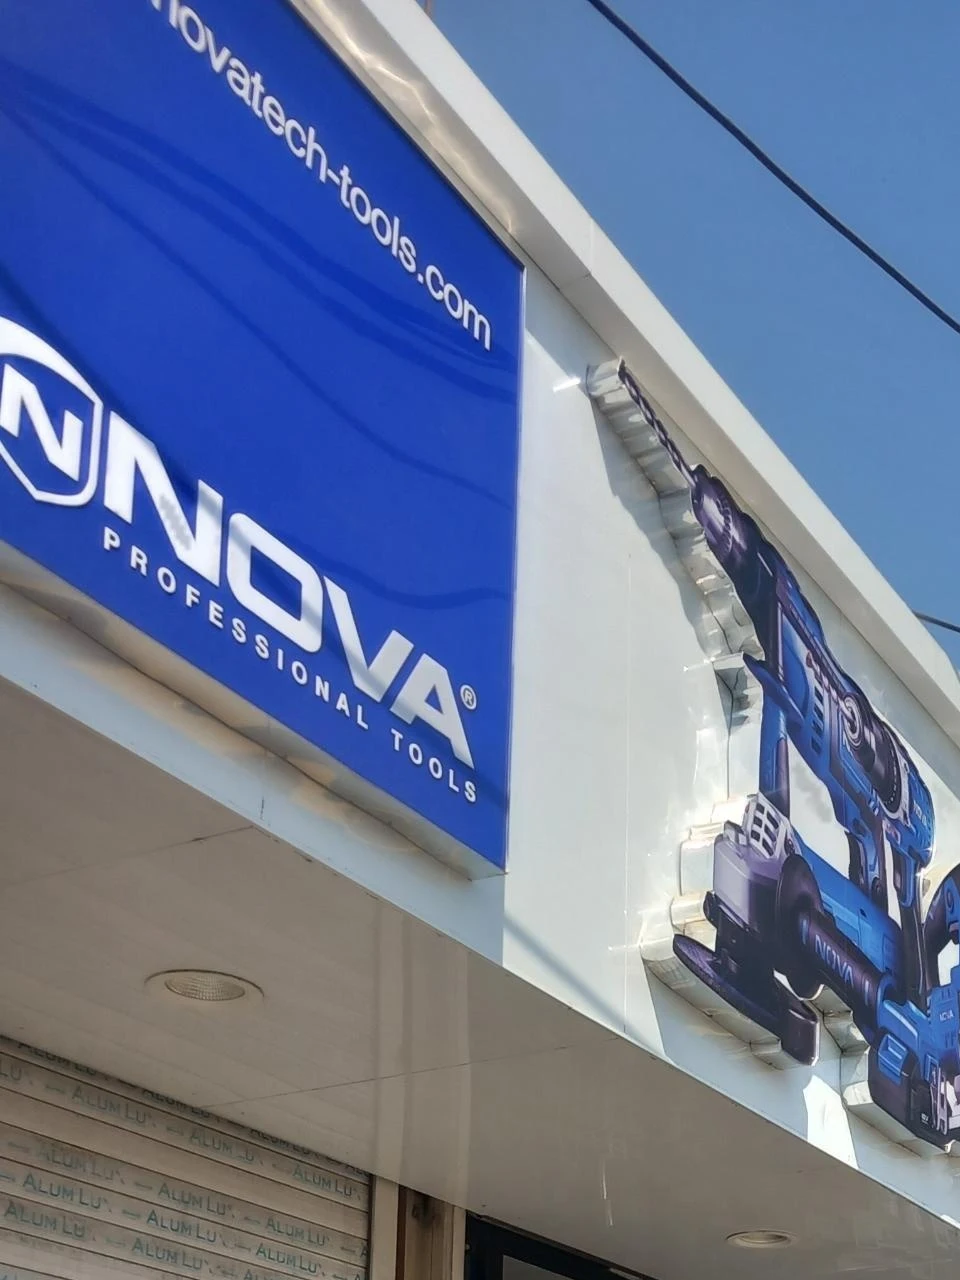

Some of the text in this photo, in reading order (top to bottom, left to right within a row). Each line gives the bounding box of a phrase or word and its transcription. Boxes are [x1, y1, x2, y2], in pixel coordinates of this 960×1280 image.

[102, 526, 477, 804] PROFESSIONAL TOOLS
[104, 411, 475, 770] NOVA
[815, 934, 855, 989] NOVA
